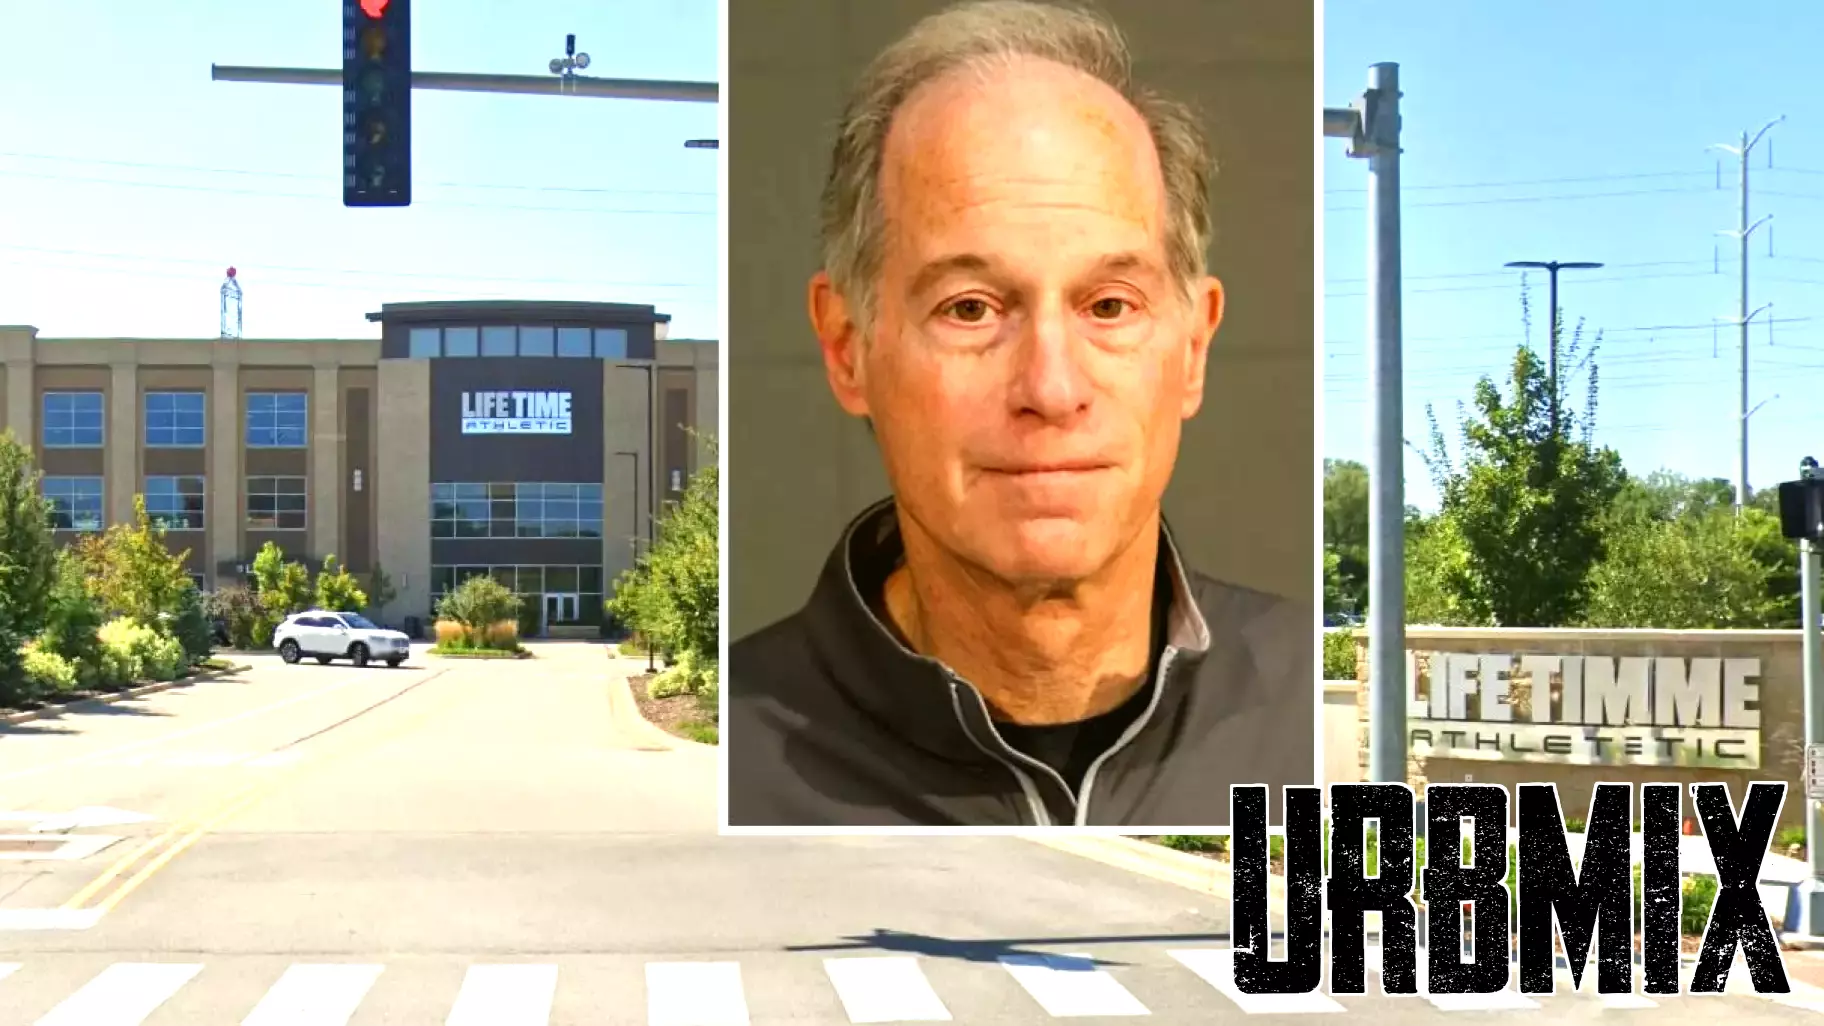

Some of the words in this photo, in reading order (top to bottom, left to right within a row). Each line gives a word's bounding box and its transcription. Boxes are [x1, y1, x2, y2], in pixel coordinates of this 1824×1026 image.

[462, 392, 509, 418] LIFE
[512, 392, 572, 418] TIME
[465, 420, 568, 430] ATHLETIC
[1406, 650, 1512, 721] LIFE
